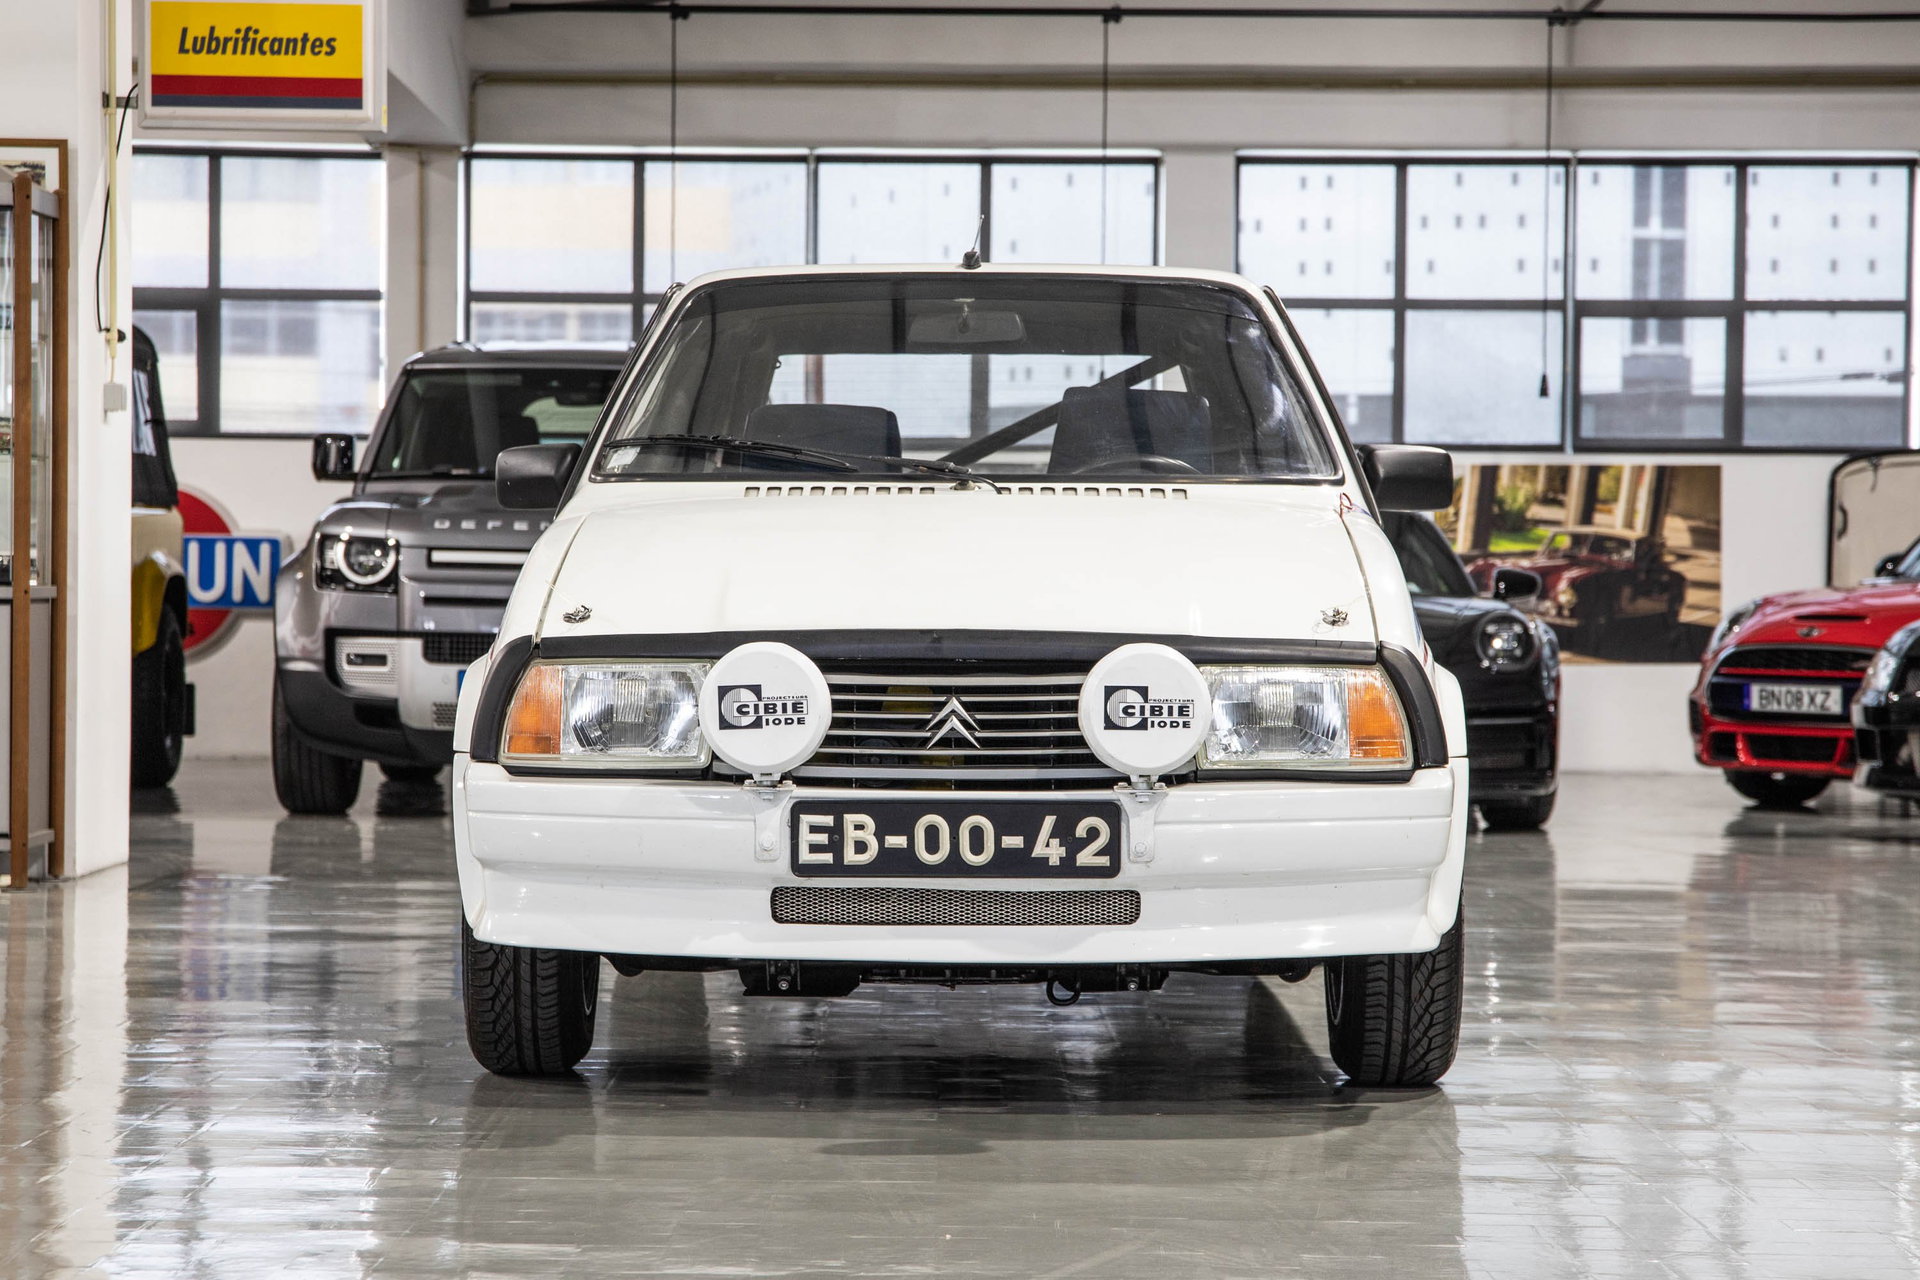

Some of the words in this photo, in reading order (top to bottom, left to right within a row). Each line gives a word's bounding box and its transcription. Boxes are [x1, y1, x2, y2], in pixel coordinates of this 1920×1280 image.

[178, 25, 337, 56] Lubrificantes
[765, 717, 806, 726] IODE
[1150, 720, 1191, 728] IODE
[799, 813, 1110, 867] EB-00-42
